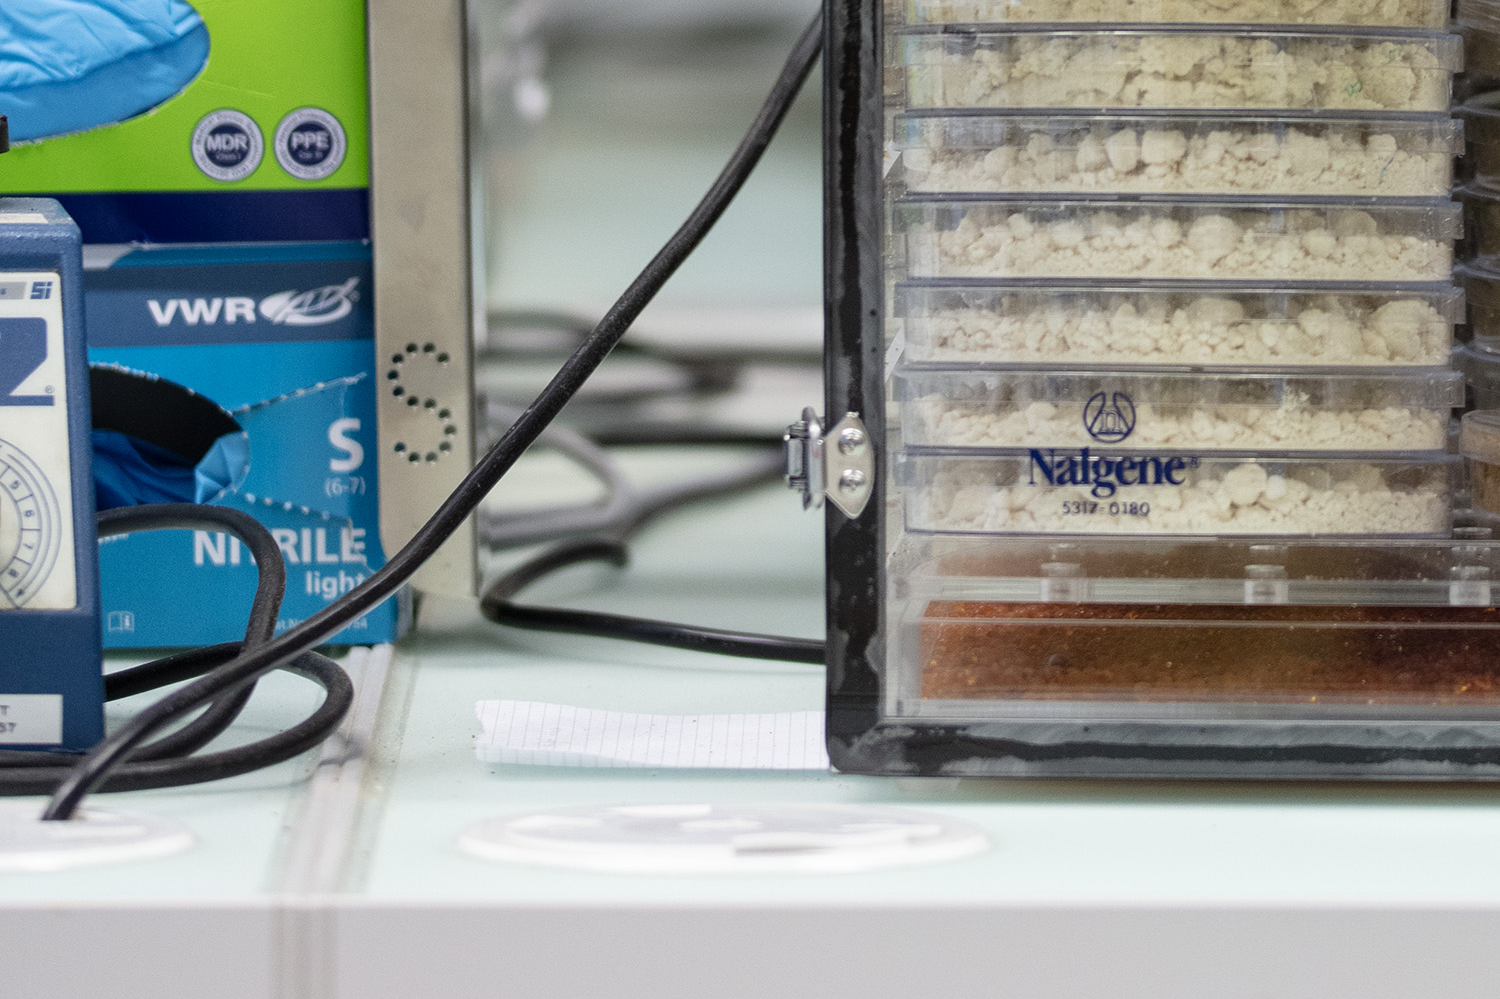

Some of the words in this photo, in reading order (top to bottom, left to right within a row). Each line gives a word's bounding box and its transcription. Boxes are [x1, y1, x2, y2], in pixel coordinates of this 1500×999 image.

[206, 132, 249, 152] MDR
[290, 130, 330, 151] PPE
[148, 296, 256, 327] VWR
[328, 417, 364, 472] S
[324, 475, 366, 497] (6-7)
[193, 526, 367, 565] NIRILE
